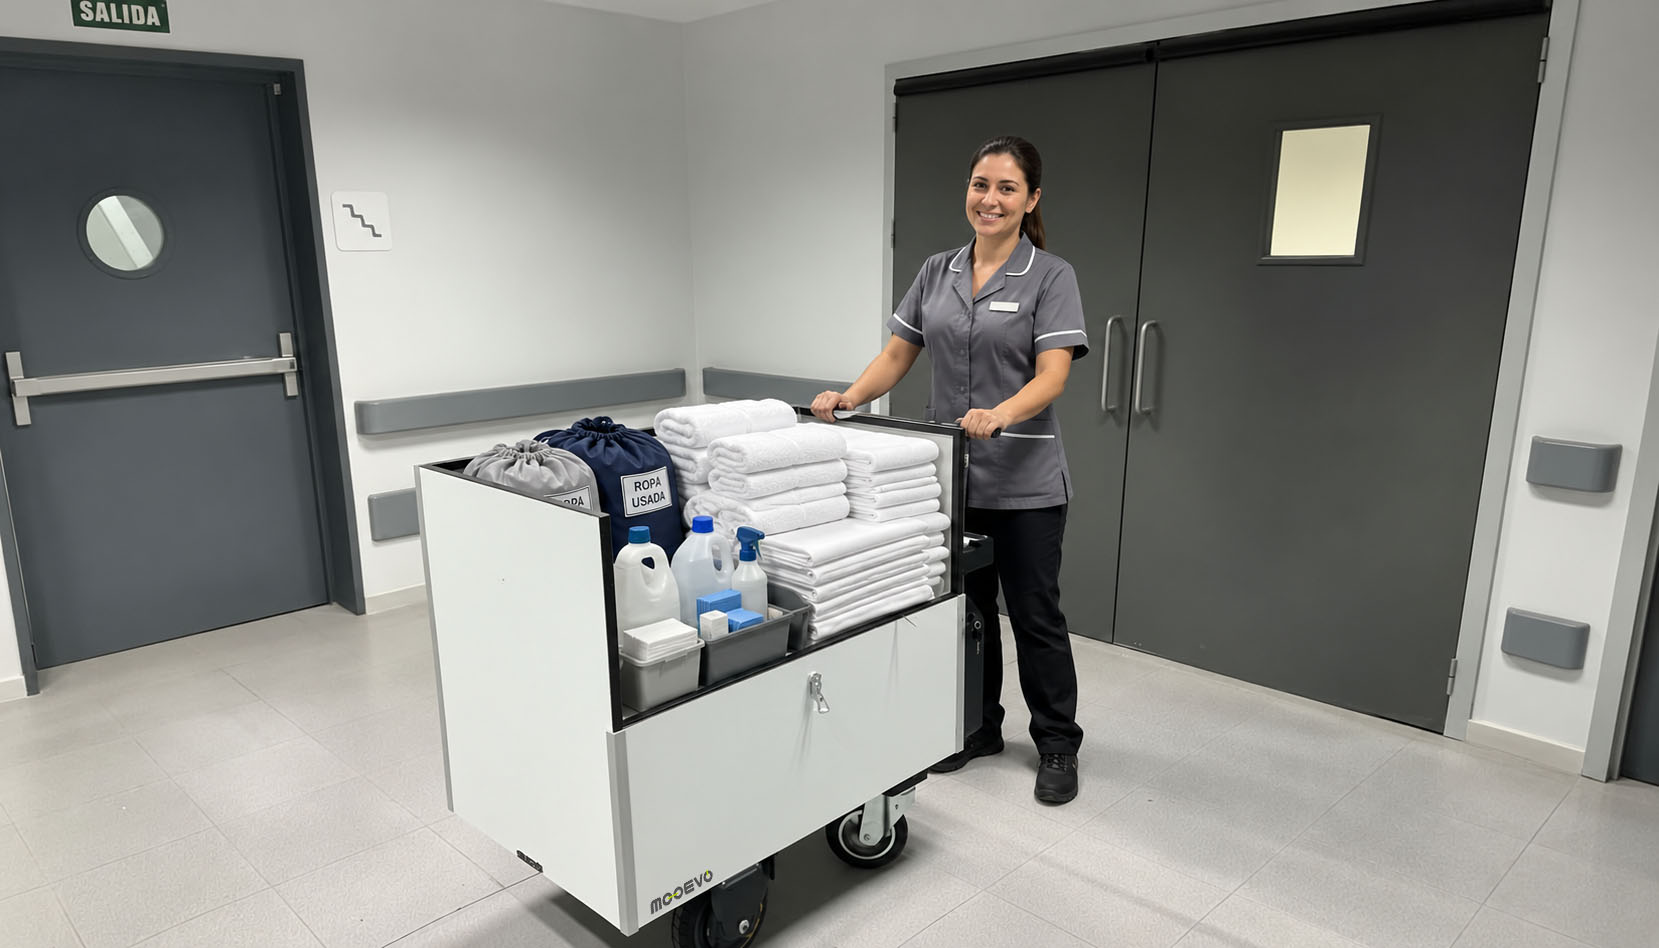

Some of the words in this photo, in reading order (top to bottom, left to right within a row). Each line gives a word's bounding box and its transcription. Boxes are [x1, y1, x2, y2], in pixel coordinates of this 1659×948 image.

[79, 0, 161, 26] SALIDA
[634, 476, 662, 492] ROPA
[632, 491, 666, 508] USADA
[650, 869, 713, 915] MOOEVO
